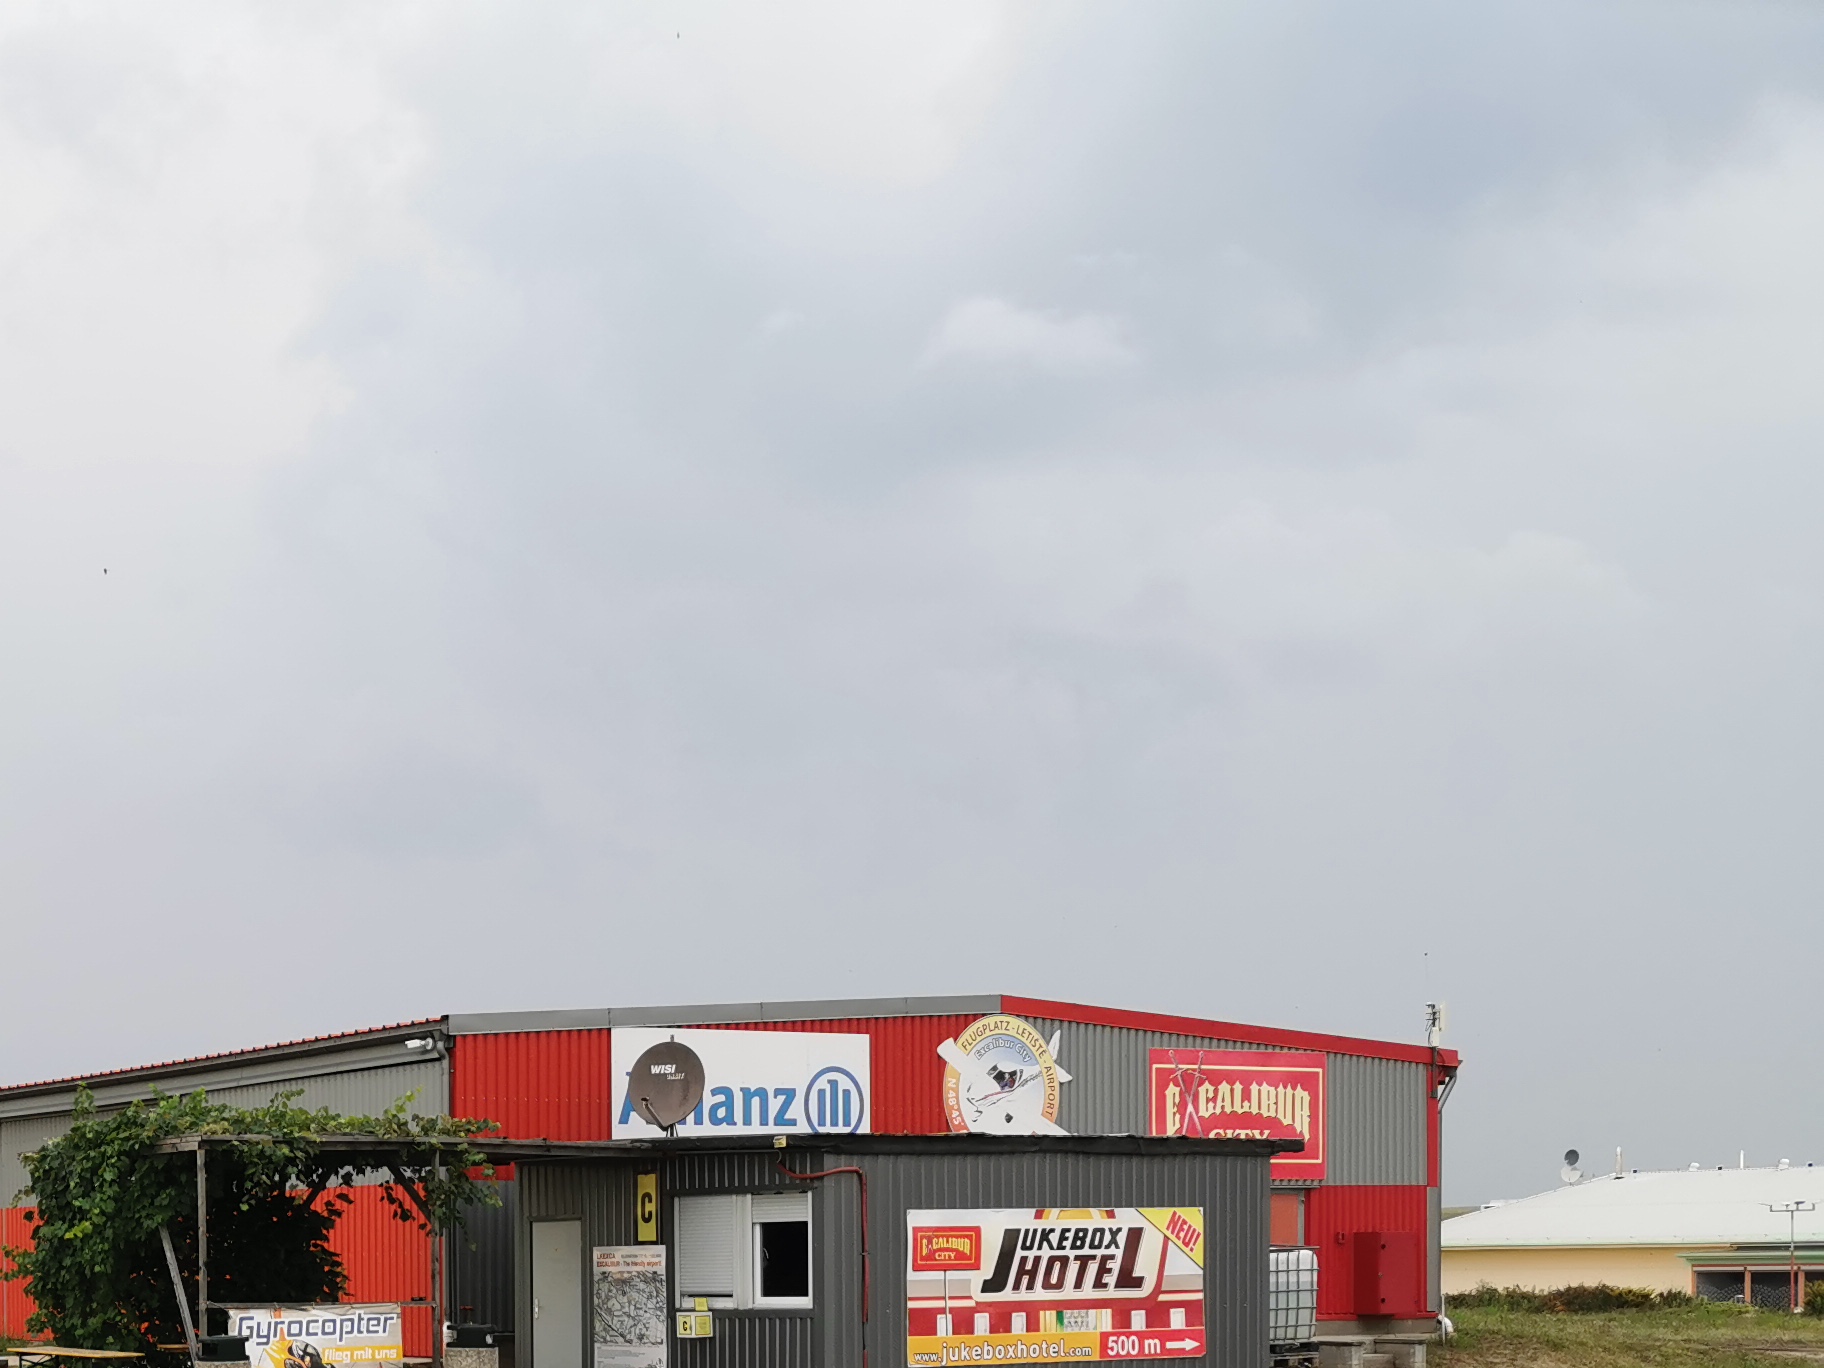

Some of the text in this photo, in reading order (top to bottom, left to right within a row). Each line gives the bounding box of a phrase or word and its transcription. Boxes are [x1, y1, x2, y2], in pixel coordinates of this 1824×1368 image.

[975, 1037, 1032, 1062] Excalibur City
[650, 1064, 676, 1074] WISI
[961, 1020, 1010, 1051] FLUGPLATZ
[1044, 1065, 1055, 1117] AIRPORT
[1165, 1080, 1311, 1143] EXCALIBUR
[641, 1191, 653, 1224] C
[1165, 1210, 1202, 1253] NEU!
[935, 1251, 956, 1260] CITY
[980, 1227, 1124, 1293] JUKEBOX
[1012, 1226, 1147, 1293] HOTEL
[238, 1313, 395, 1346] Gyrocopter
[324, 1347, 397, 1364] flieg mit uns
[913, 1338, 1094, 1366] www.jukeboxhotel.com
[1107, 1336, 1162, 1357] 500 m
